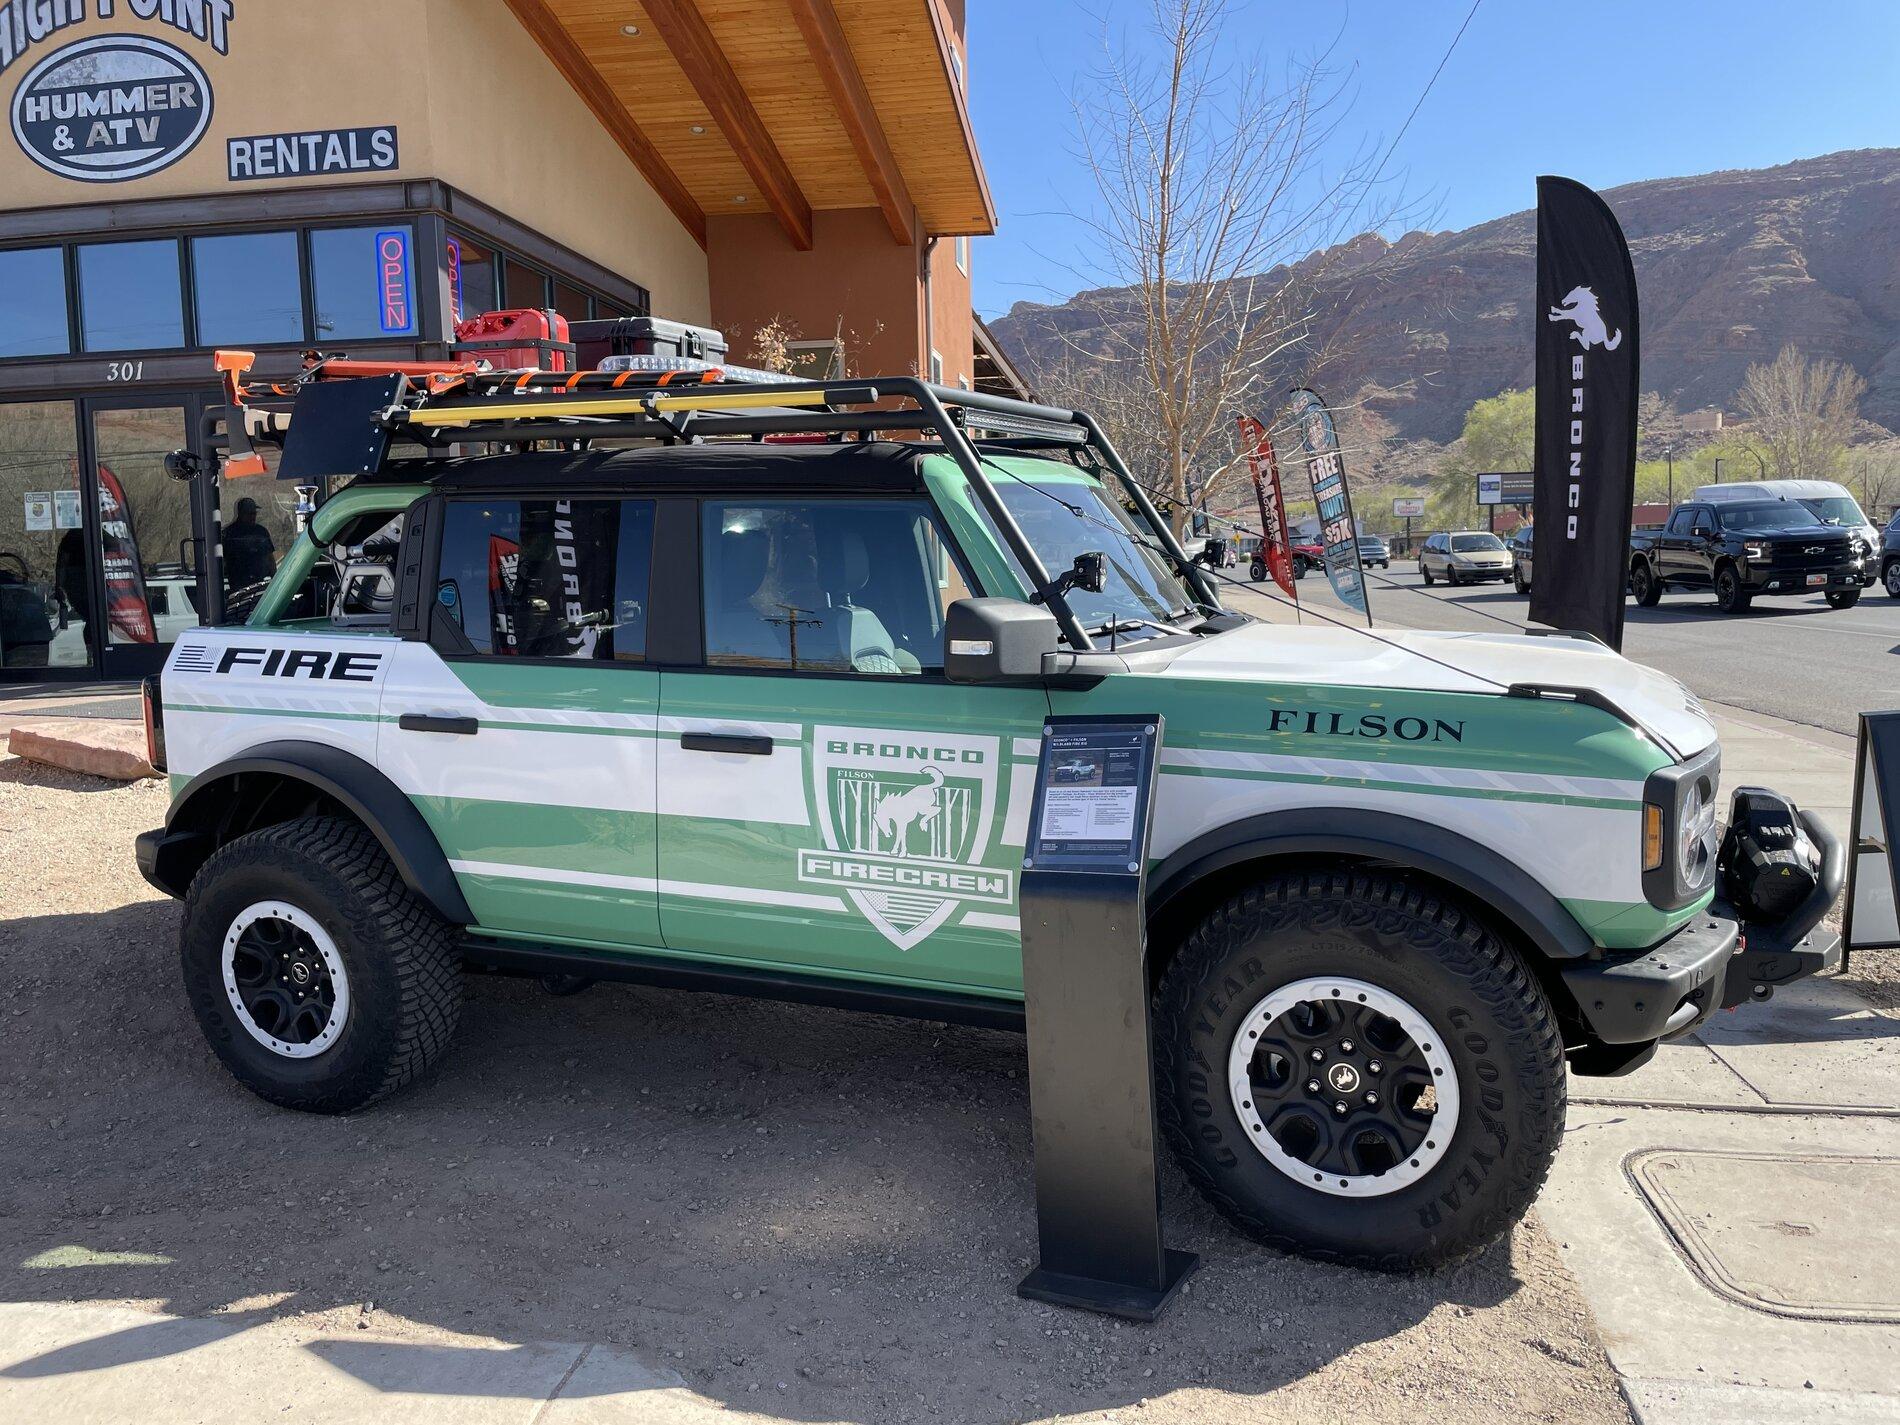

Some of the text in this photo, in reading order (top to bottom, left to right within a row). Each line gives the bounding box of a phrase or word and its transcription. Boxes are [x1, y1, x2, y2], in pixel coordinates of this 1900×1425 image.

[25, 81, 198, 123] HUMMER
[52, 116, 161, 152] & ATV
[229, 129, 395, 178] RENTALS
[381, 238, 405, 328] OPEN
[106, 361, 144, 382] 301
[1566, 354, 1584, 540] BRONCO
[1309, 452, 1339, 484] FREE
[1319, 492, 1347, 521] HUNT
[1325, 518, 1352, 544] $5K
[215, 647, 382, 682] FIRE
[1266, 709, 1467, 743] FILSON
[827, 740, 984, 764] BRONCO
[837, 769, 875, 779] FILSON
[806, 858, 1004, 894] FIRECREW
